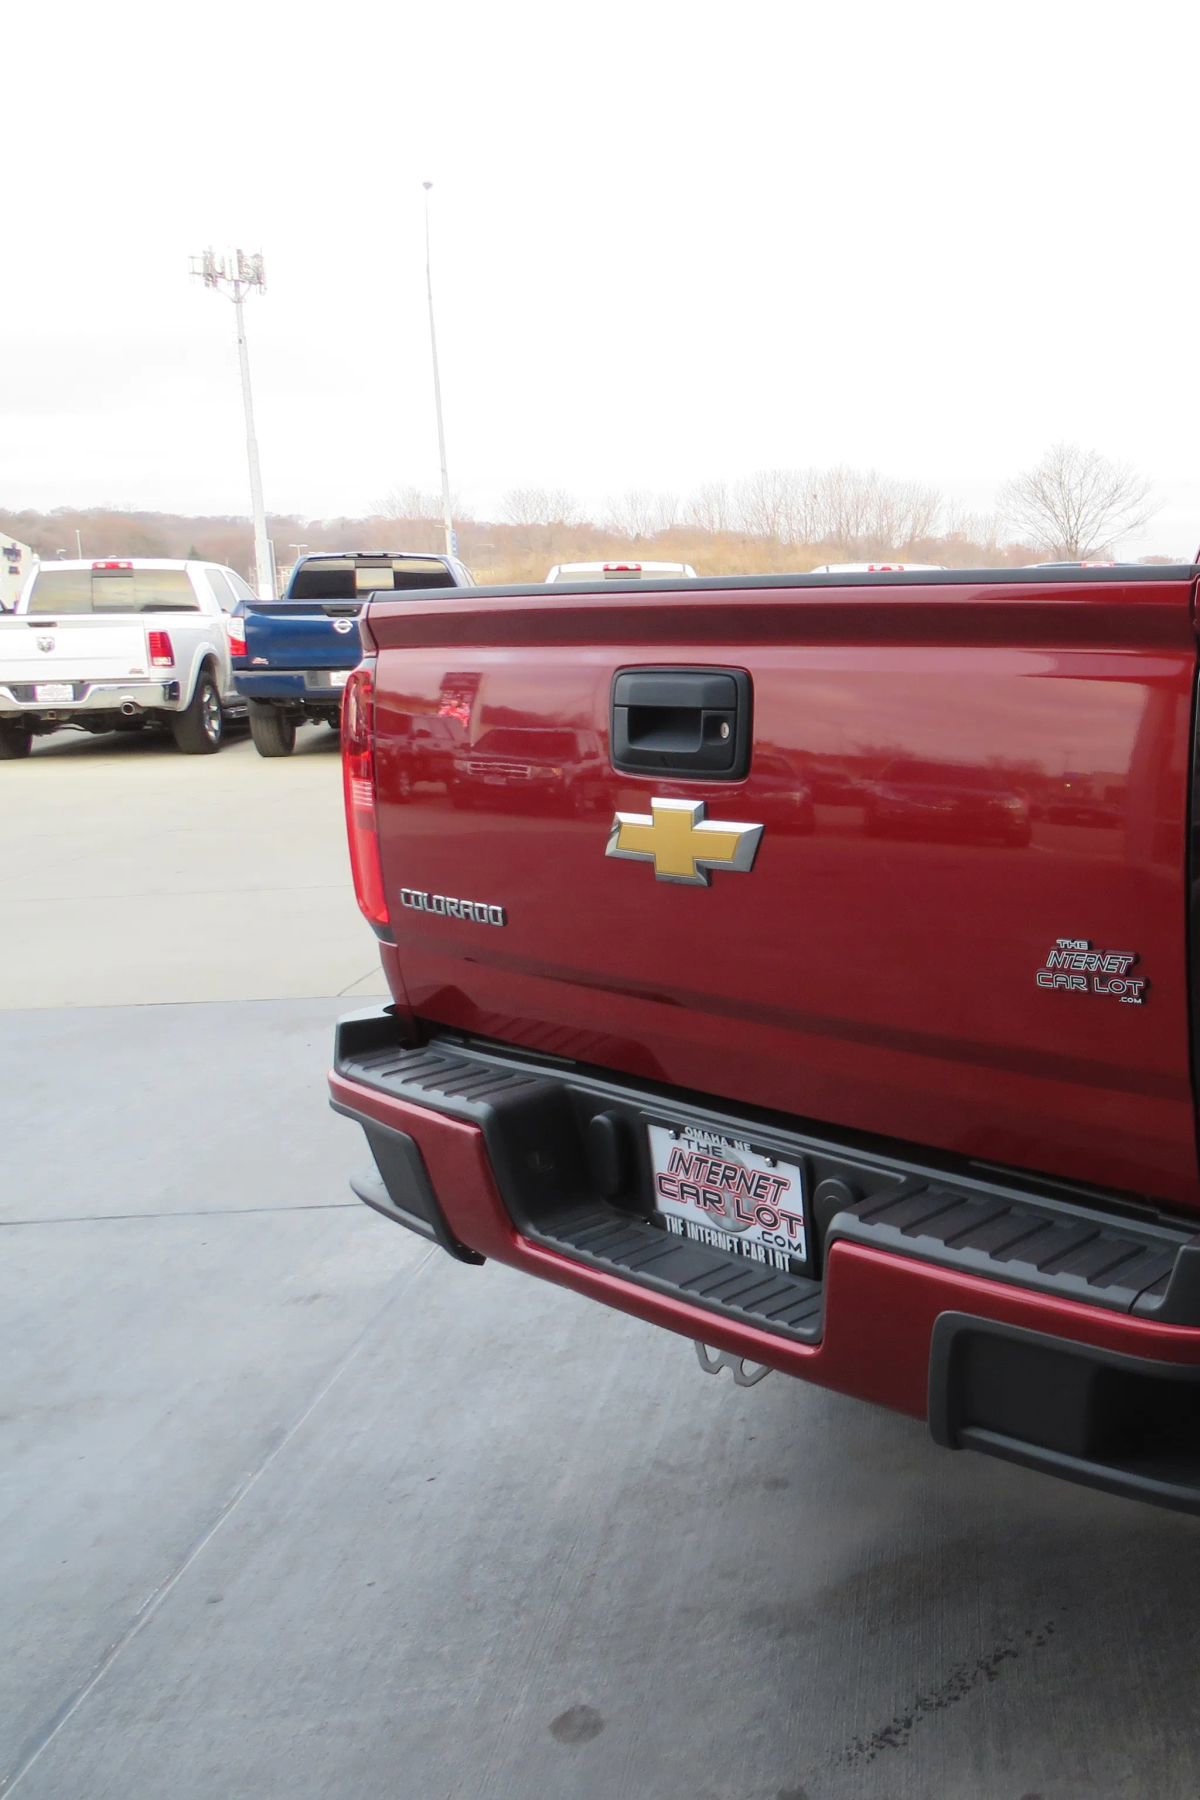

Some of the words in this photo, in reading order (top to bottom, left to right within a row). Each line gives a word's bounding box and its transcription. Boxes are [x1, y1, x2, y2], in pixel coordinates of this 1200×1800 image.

[400, 888, 504, 926] COLORADO
[1056, 938, 1089, 950] THE
[1046, 950, 1134, 974] INTERNET
[1036, 972, 1088, 991] CAR
[1094, 977, 1144, 996] LOT
[682, 1138, 724, 1158] THE
[733, 1140, 752, 1152] NE
[668, 1147, 791, 1206] INTERNET
[656, 1173, 726, 1217] CAR
[734, 1195, 804, 1238] LOT
[742, 1240, 766, 1264] CAR
[757, 1231, 803, 1254] .COM
